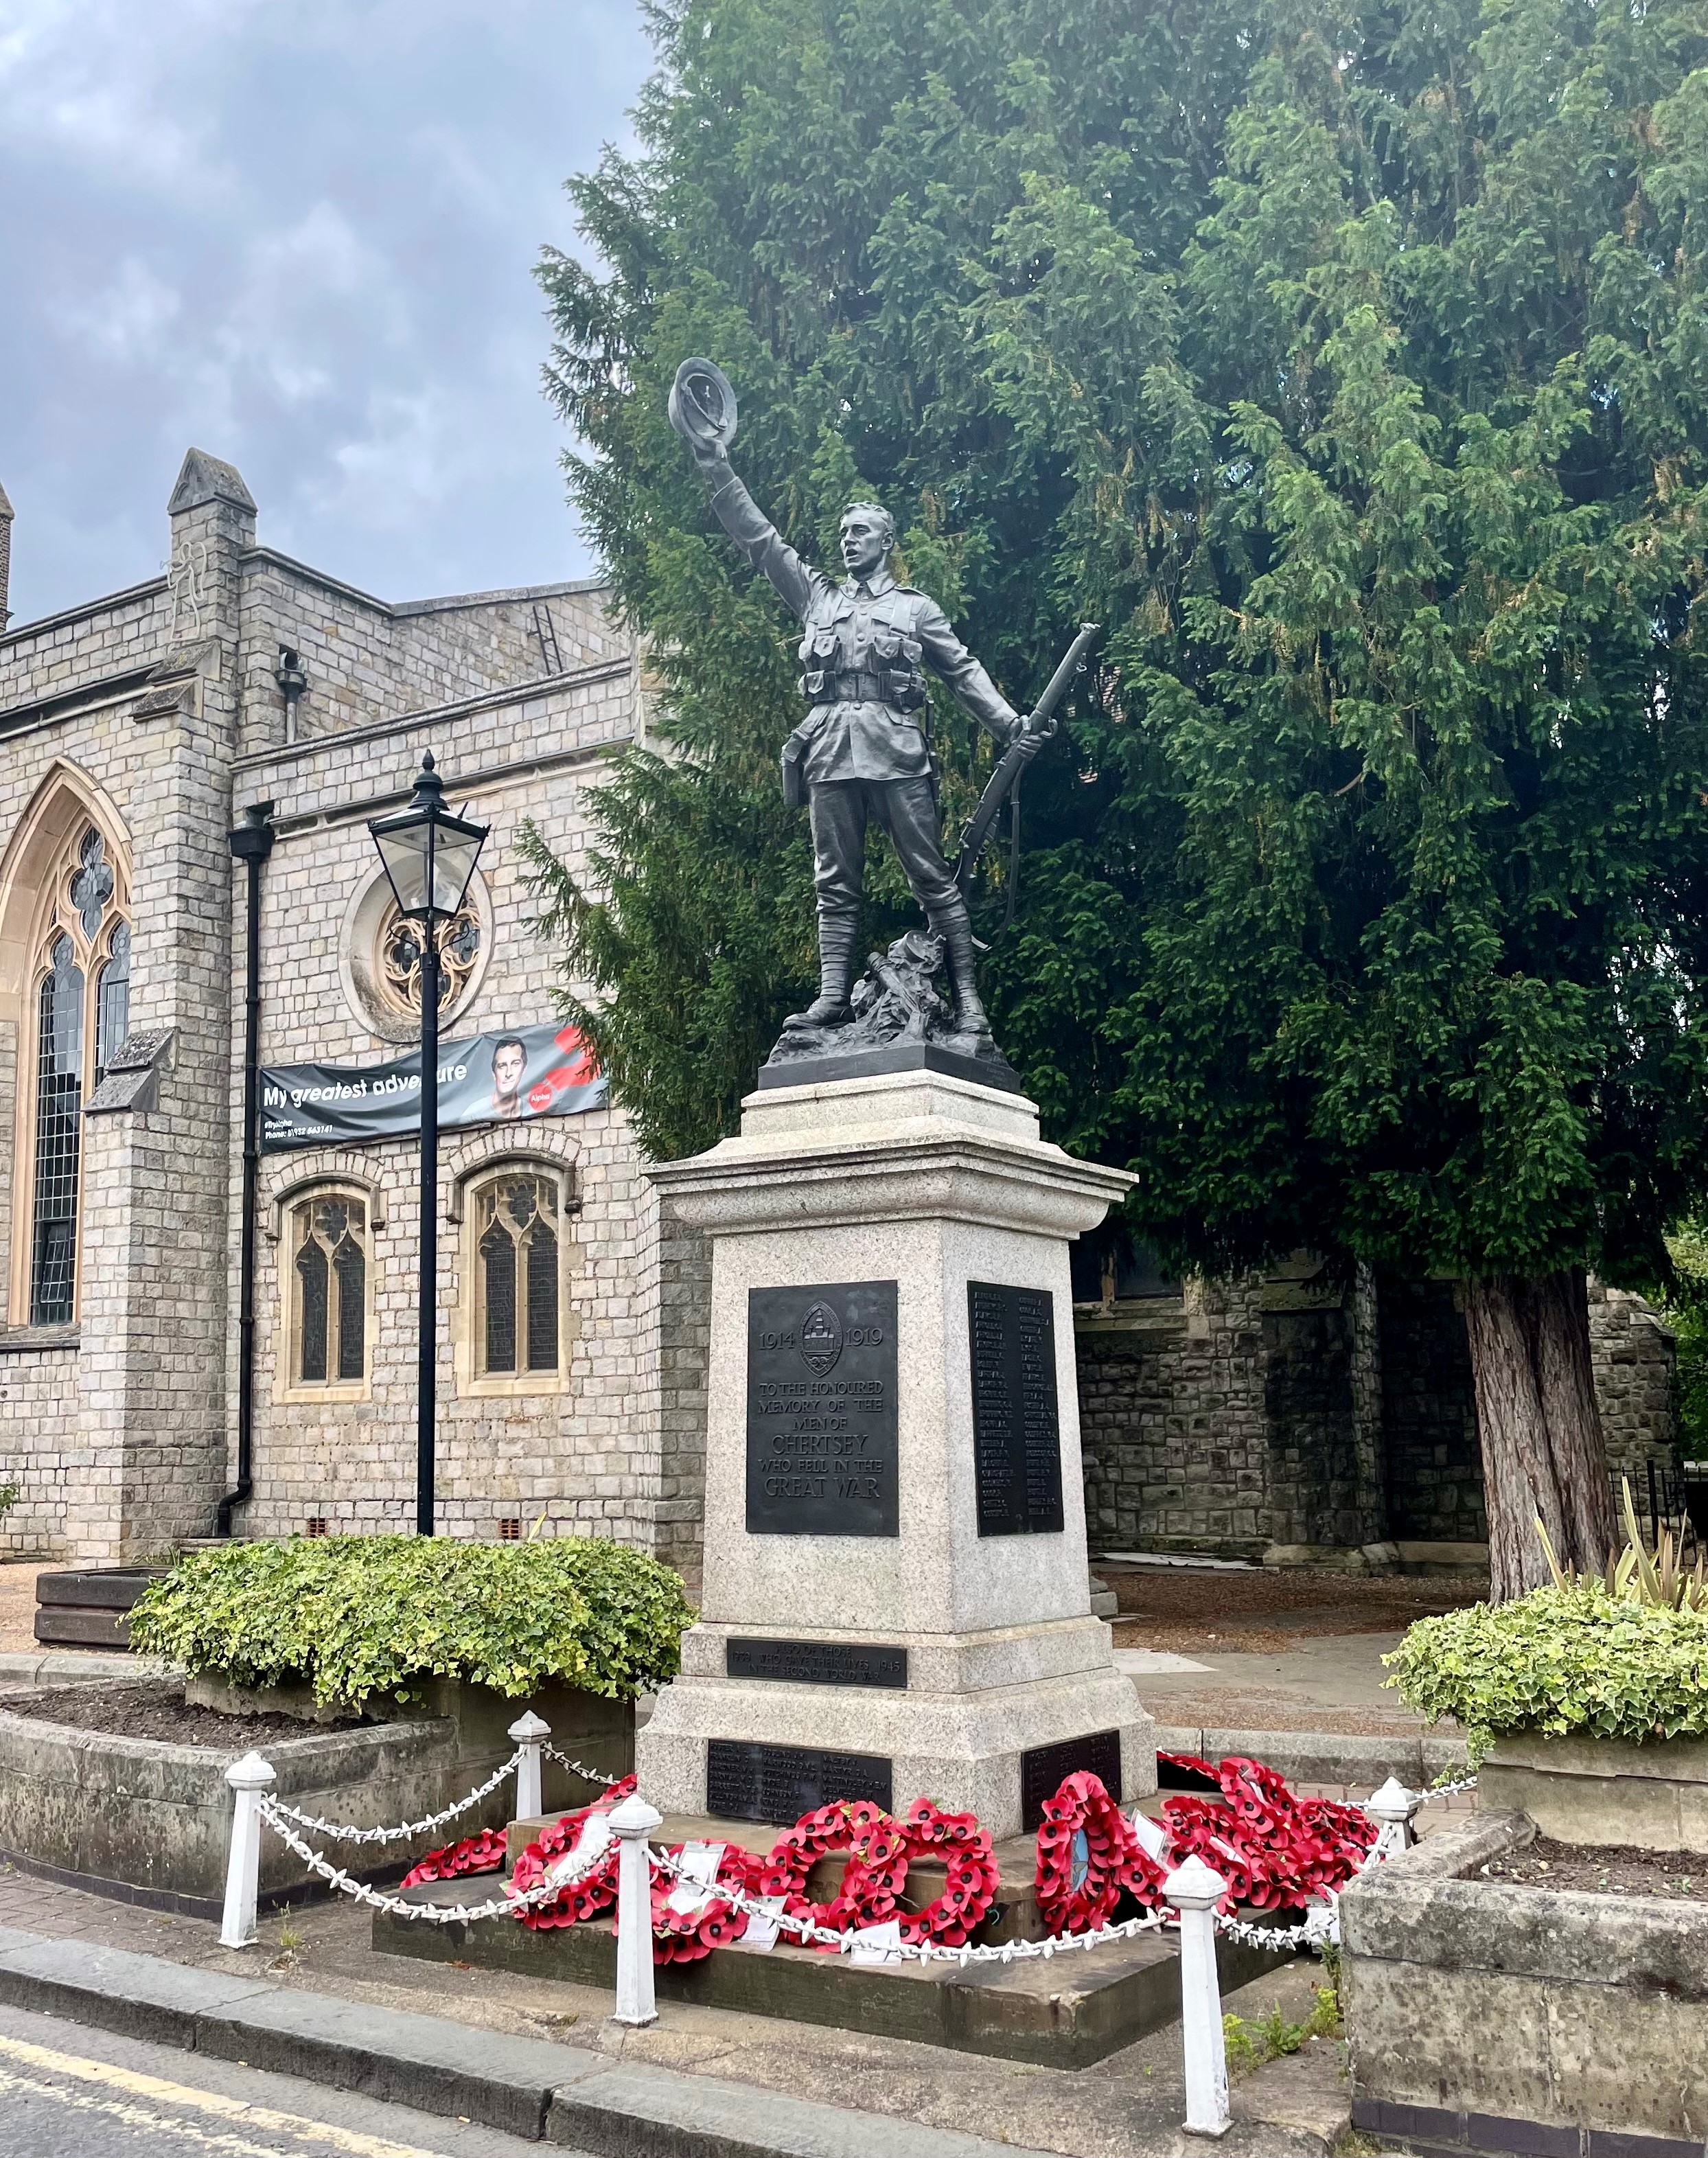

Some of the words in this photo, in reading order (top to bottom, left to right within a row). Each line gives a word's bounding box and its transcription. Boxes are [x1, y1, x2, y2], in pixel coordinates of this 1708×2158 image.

[264, 1087, 287, 1109] My
[290, 1079, 367, 1108] greatest
[373, 1064, 468, 1096] adveure
[531, 1093, 551, 1103] Alpha
[265, 1131, 287, 1140] Phone:
[288, 1127, 306, 1138] 01932
[759, 1331, 795, 1350] 1914
[846, 1328, 884, 1347] 1919
[759, 1383, 776, 1397] TO
[779, 1382, 806, 1396] THE
[810, 1380, 884, 1395] HONOURED
[758, 1399, 820, 1414] MEMORY
[828, 1399, 845, 1412] OF
[853, 1398, 884, 1412] THE
[792, 1417, 827, 1431] MEN
[830, 1416, 848, 1430] OF
[772, 1434, 869, 1456] CHERTSEY
[758, 1459, 792, 1473] WHO
[798, 1459, 829, 1473] FELL
[833, 1459, 850, 1473] IN
[854, 1459, 883, 1473] THE
[764, 1476, 827, 1497] GREAT
[833, 1477, 881, 1498] WAR
[805, 1645, 818, 1655] OF
[820, 1646, 852, 1658] THOSE
[759, 1653, 781, 1664] WHO
[785, 1655, 811, 1666] GAVE
[811, 1657, 840, 1668] THEIR
[844, 1658, 869, 1670] LIVES
[878, 1660, 901, 1673] 1945
[781, 1666, 820, 1678] SECOND
[823, 1668, 857, 1680] WORLD
[860, 1671, 882, 1682] WAR
